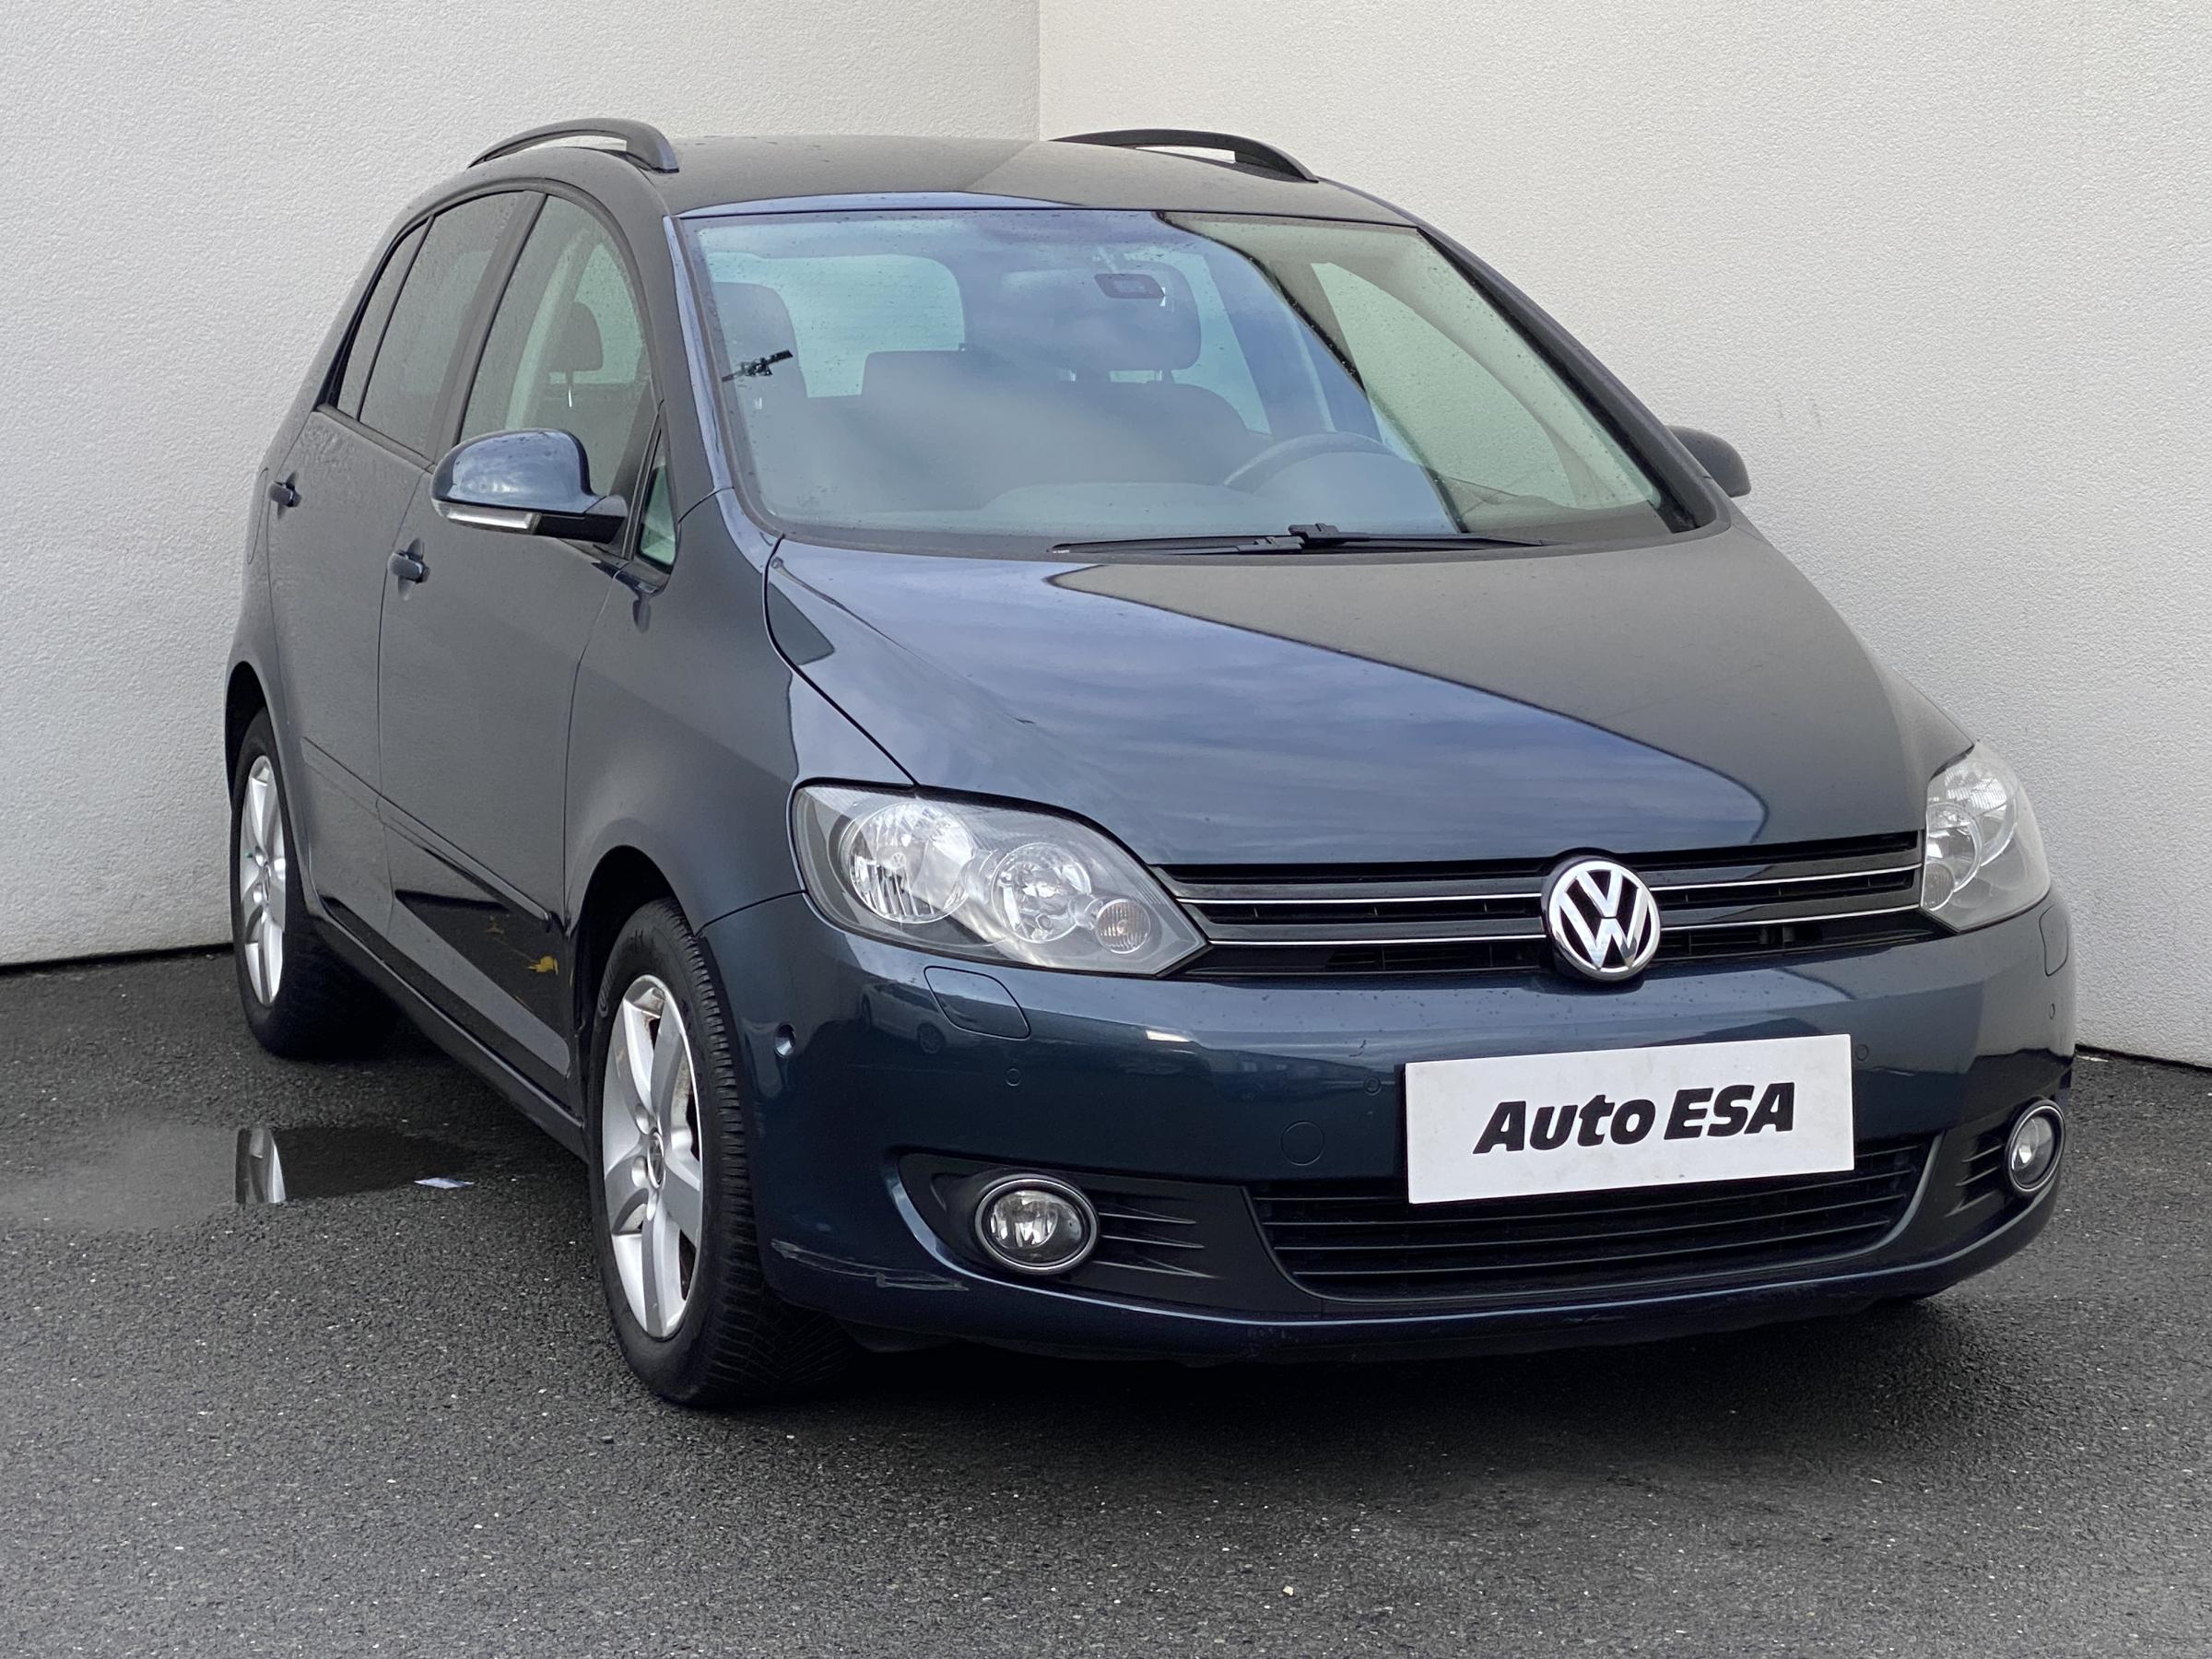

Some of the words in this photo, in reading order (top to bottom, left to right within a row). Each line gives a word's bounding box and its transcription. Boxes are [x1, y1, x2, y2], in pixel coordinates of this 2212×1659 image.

[1551, 863, 1659, 973] VW
[1473, 1095, 1656, 1154] Auto
[1664, 1082, 1794, 1140] ESA
